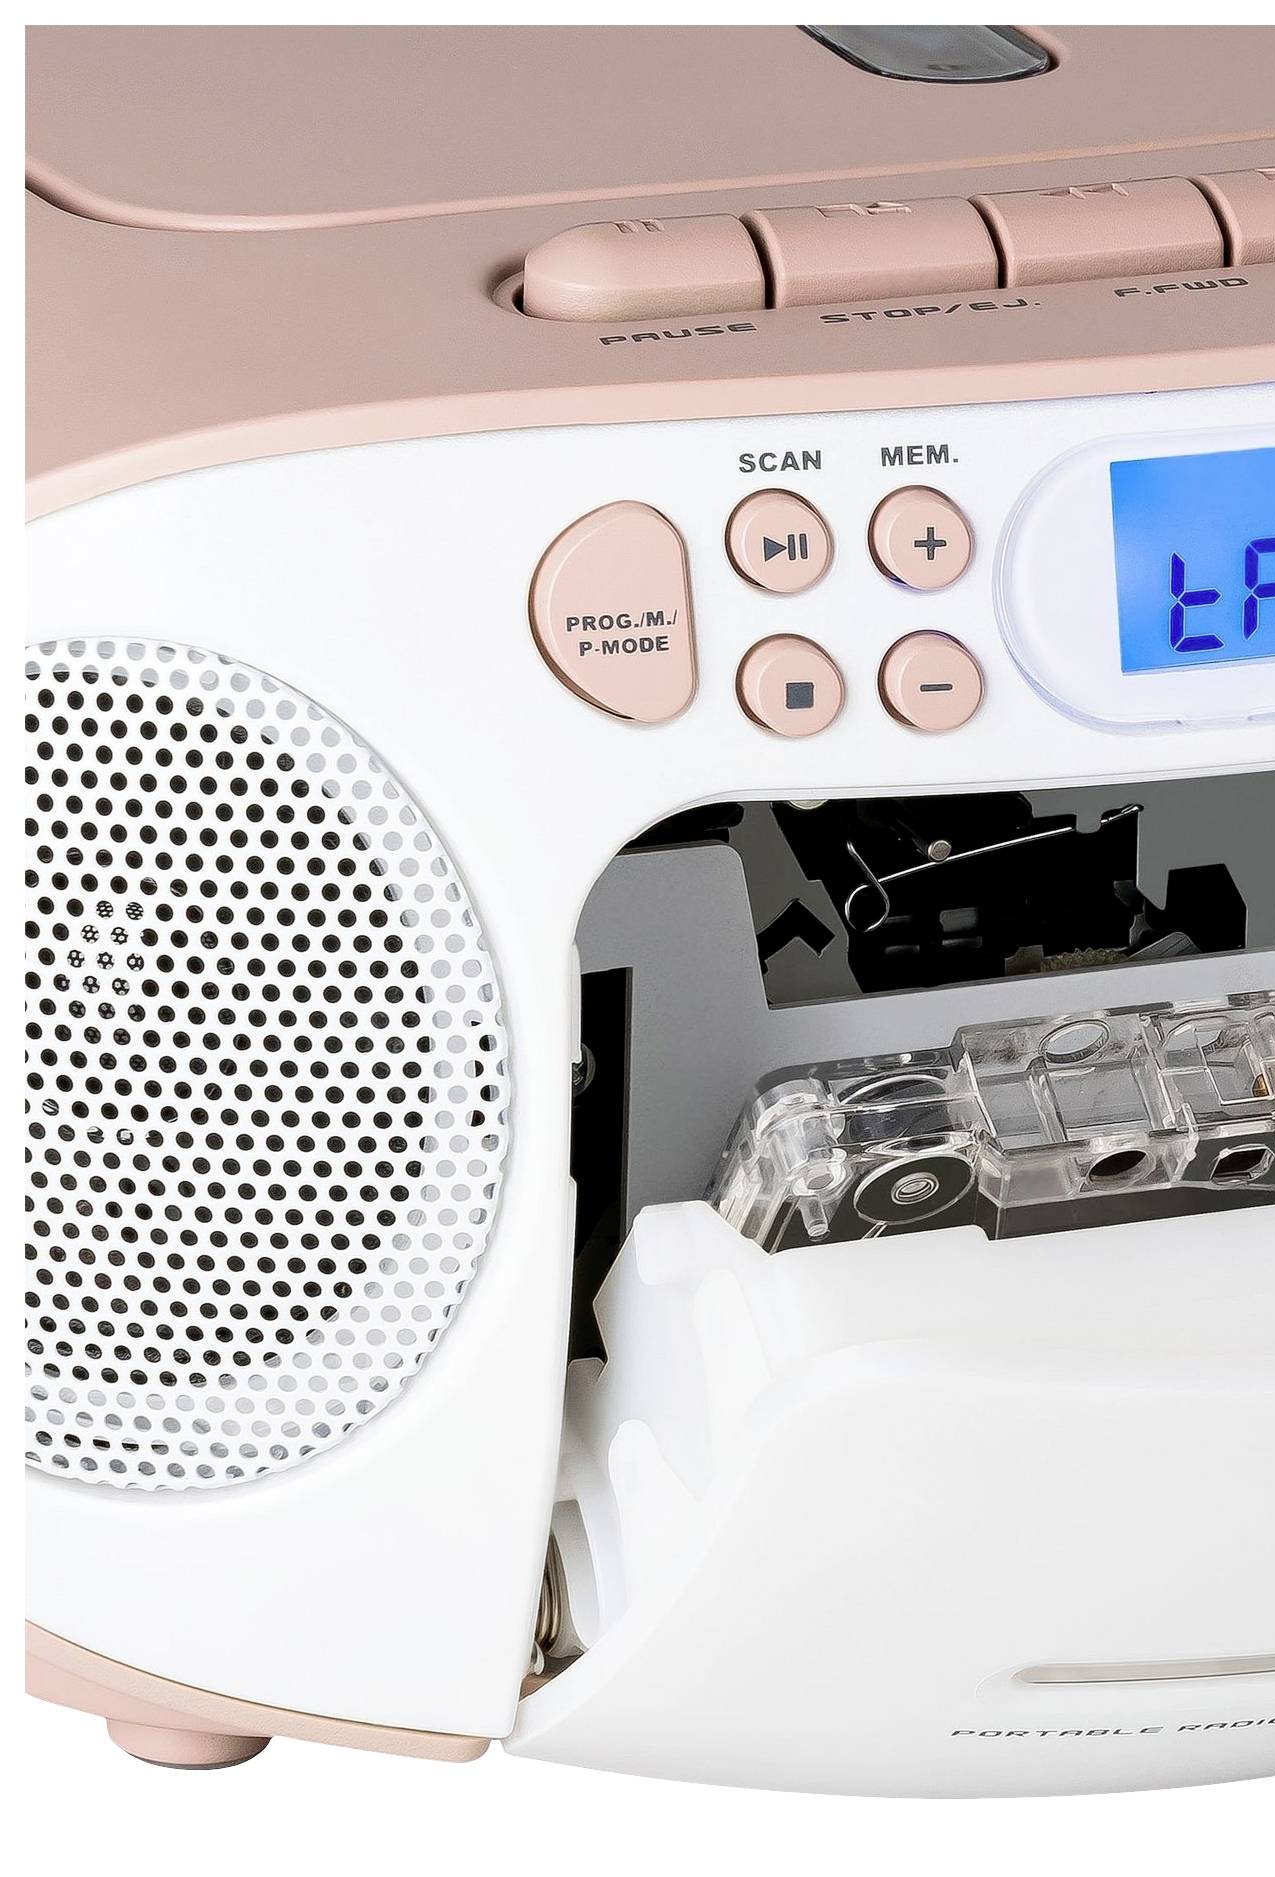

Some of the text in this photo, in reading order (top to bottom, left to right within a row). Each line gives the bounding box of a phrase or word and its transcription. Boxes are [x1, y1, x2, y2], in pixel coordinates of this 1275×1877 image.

[1113, 277, 1249, 298] F.FWD
[819, 298, 1041, 325] STOP/EJ.
[600, 322, 757, 346] PAUSE
[739, 450, 823, 473] SCAN
[881, 444, 959, 467] MEM.
[566, 609, 678, 632] PROG./M./
[579, 635, 670, 657] P-MODE
[950, 1726, 1164, 1739] PORTABLE
